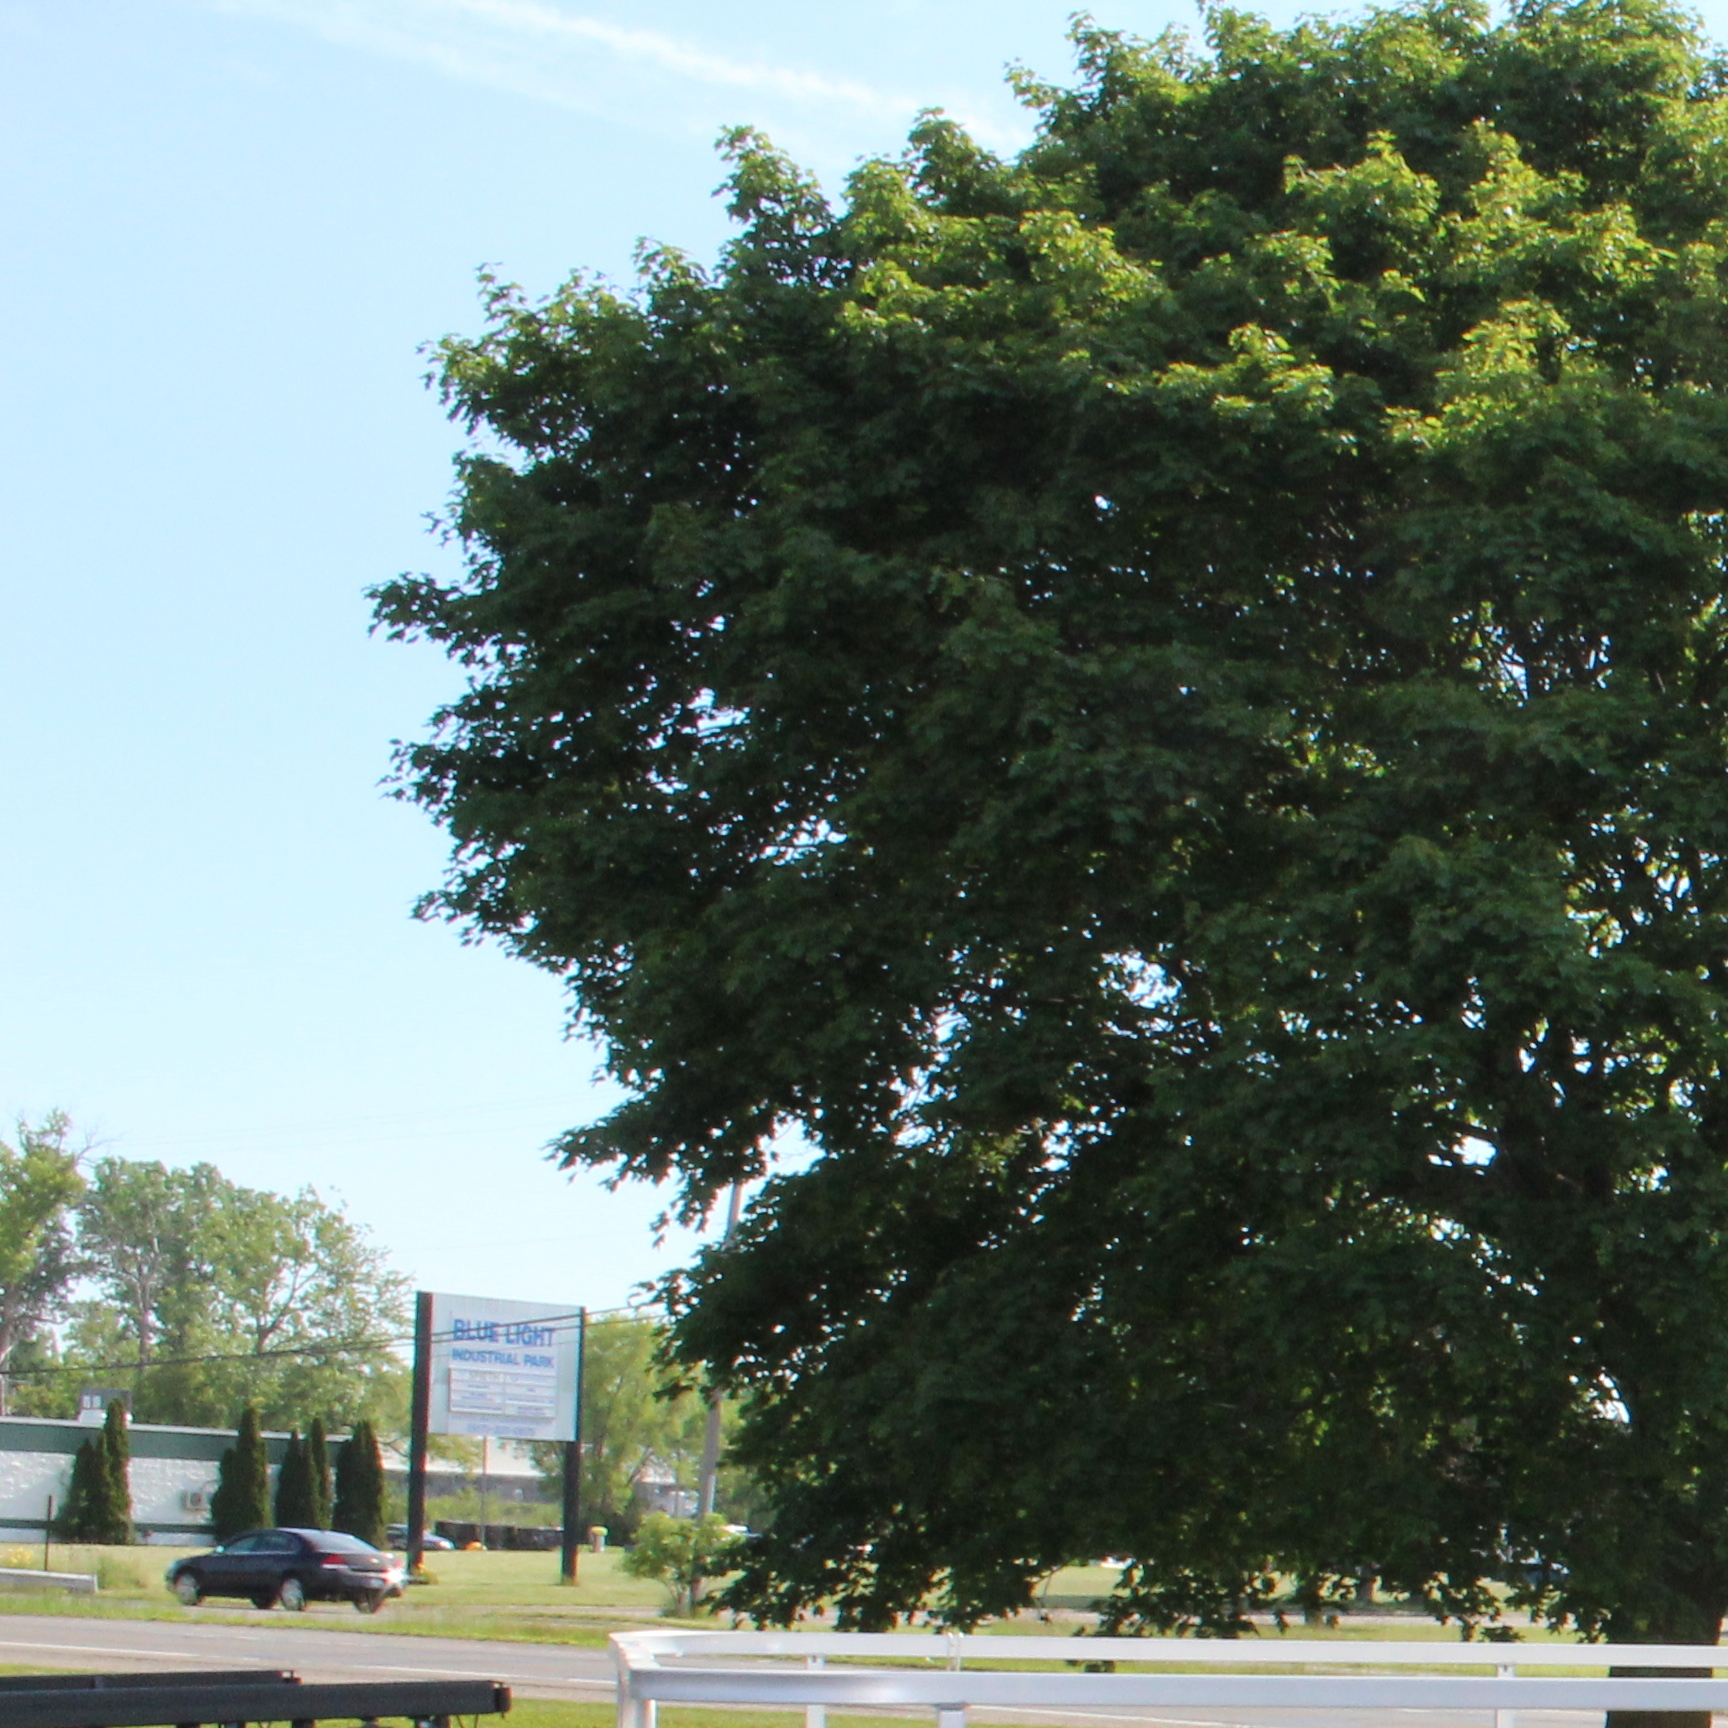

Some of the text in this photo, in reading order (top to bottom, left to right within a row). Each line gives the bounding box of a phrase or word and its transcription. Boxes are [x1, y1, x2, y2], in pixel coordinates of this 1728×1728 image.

[452, 1318, 556, 1347] BLUE LIGHT
[452, 1347, 556, 1369] INDUSTRIAL PARK
